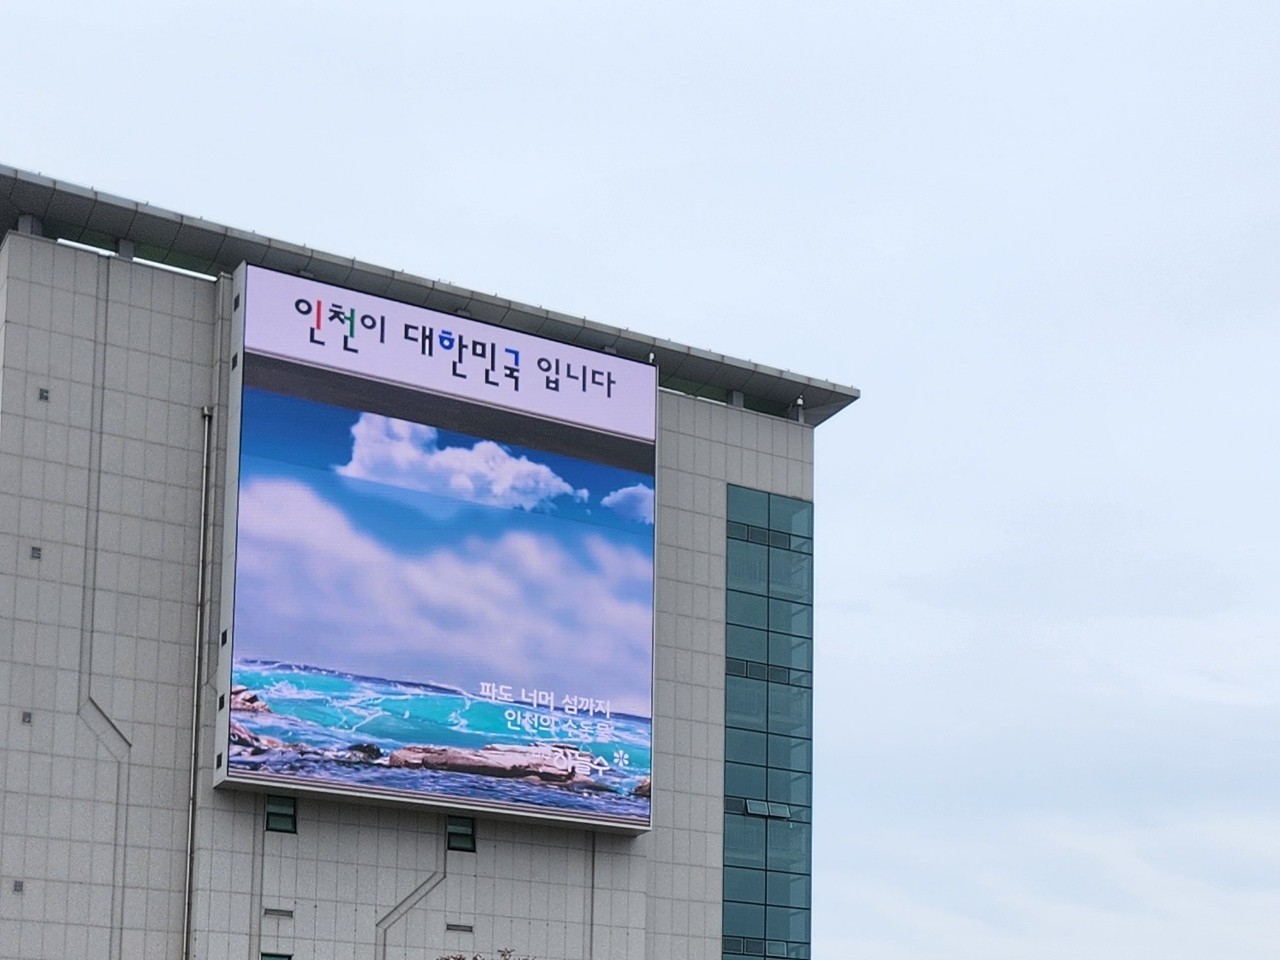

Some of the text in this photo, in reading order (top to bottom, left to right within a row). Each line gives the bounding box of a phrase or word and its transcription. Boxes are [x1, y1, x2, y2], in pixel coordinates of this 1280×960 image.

[294, 297, 616, 399] 인천이 대한민국 입니다
[479, 681, 611, 719] 파도 너머 섬까지
[504, 709, 557, 734] 인천의
